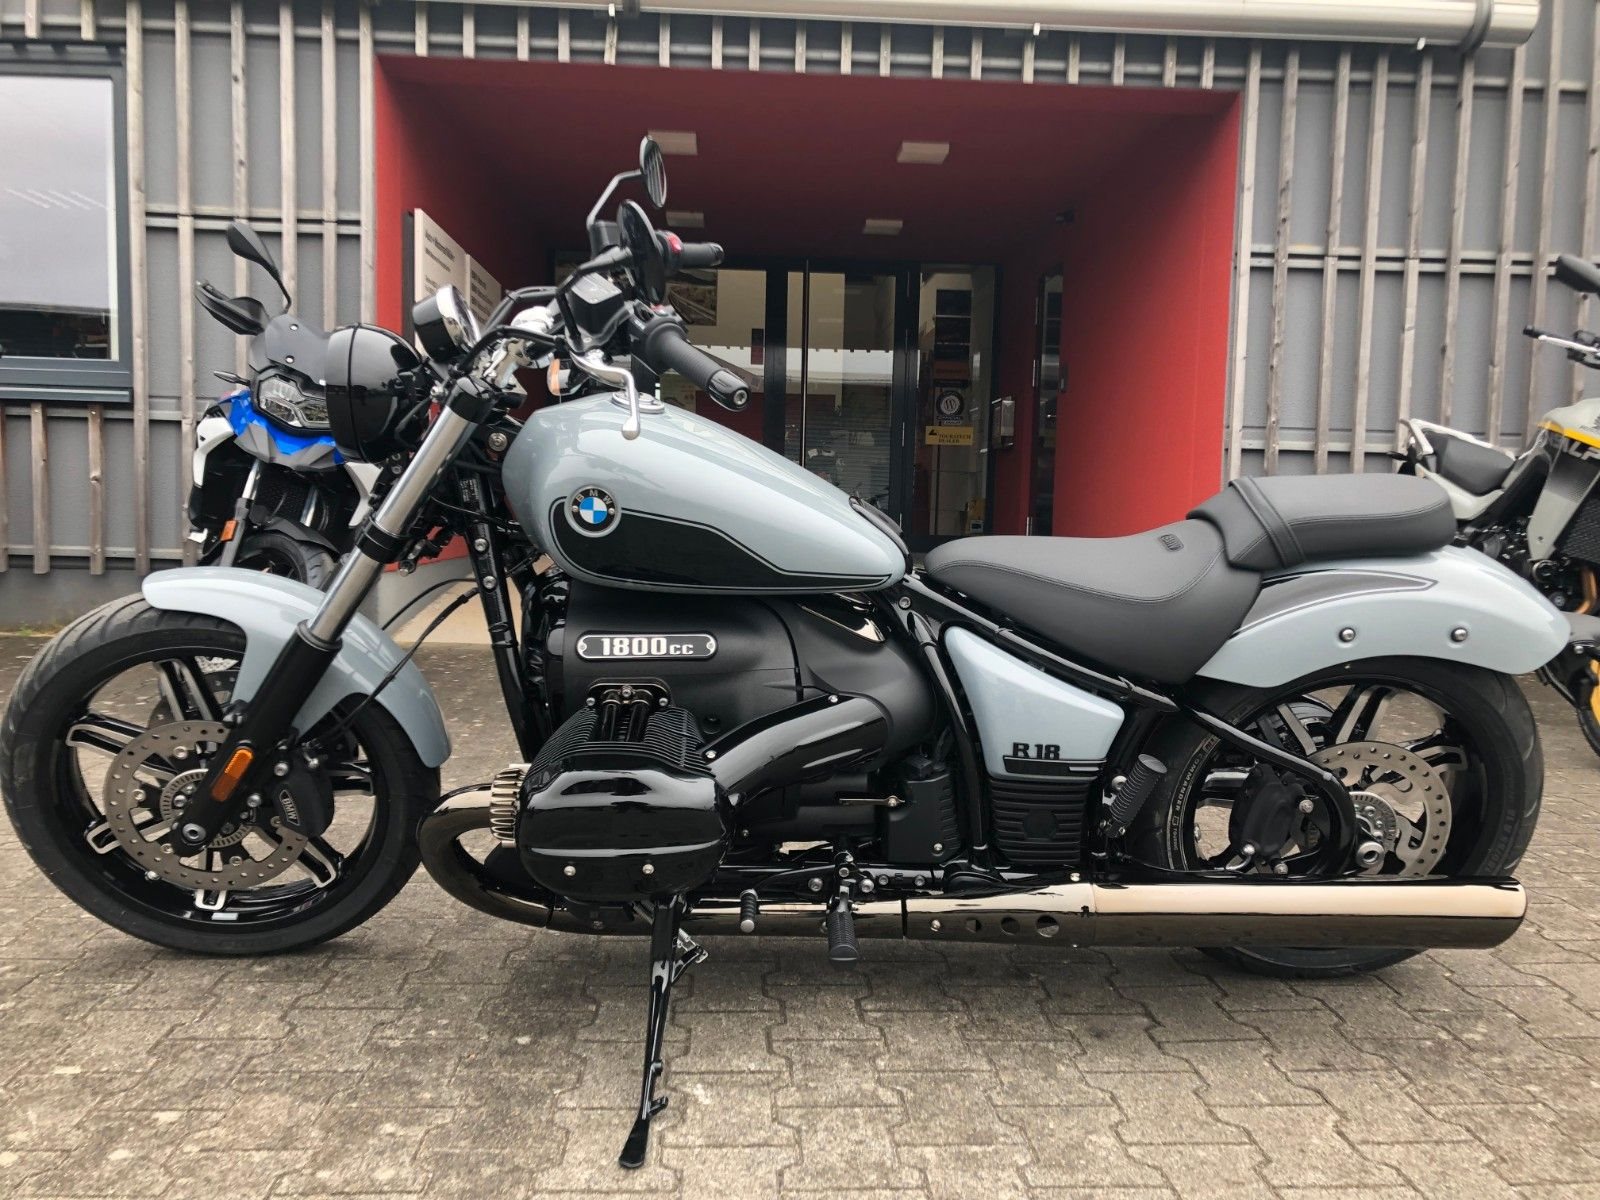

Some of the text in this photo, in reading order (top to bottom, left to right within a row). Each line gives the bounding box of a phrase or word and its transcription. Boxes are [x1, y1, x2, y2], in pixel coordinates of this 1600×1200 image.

[576, 489, 613, 505] BMW
[600, 637, 694, 656] 1800cc
[1012, 742, 1061, 760] R 18
[281, 798, 298, 820] BMW
